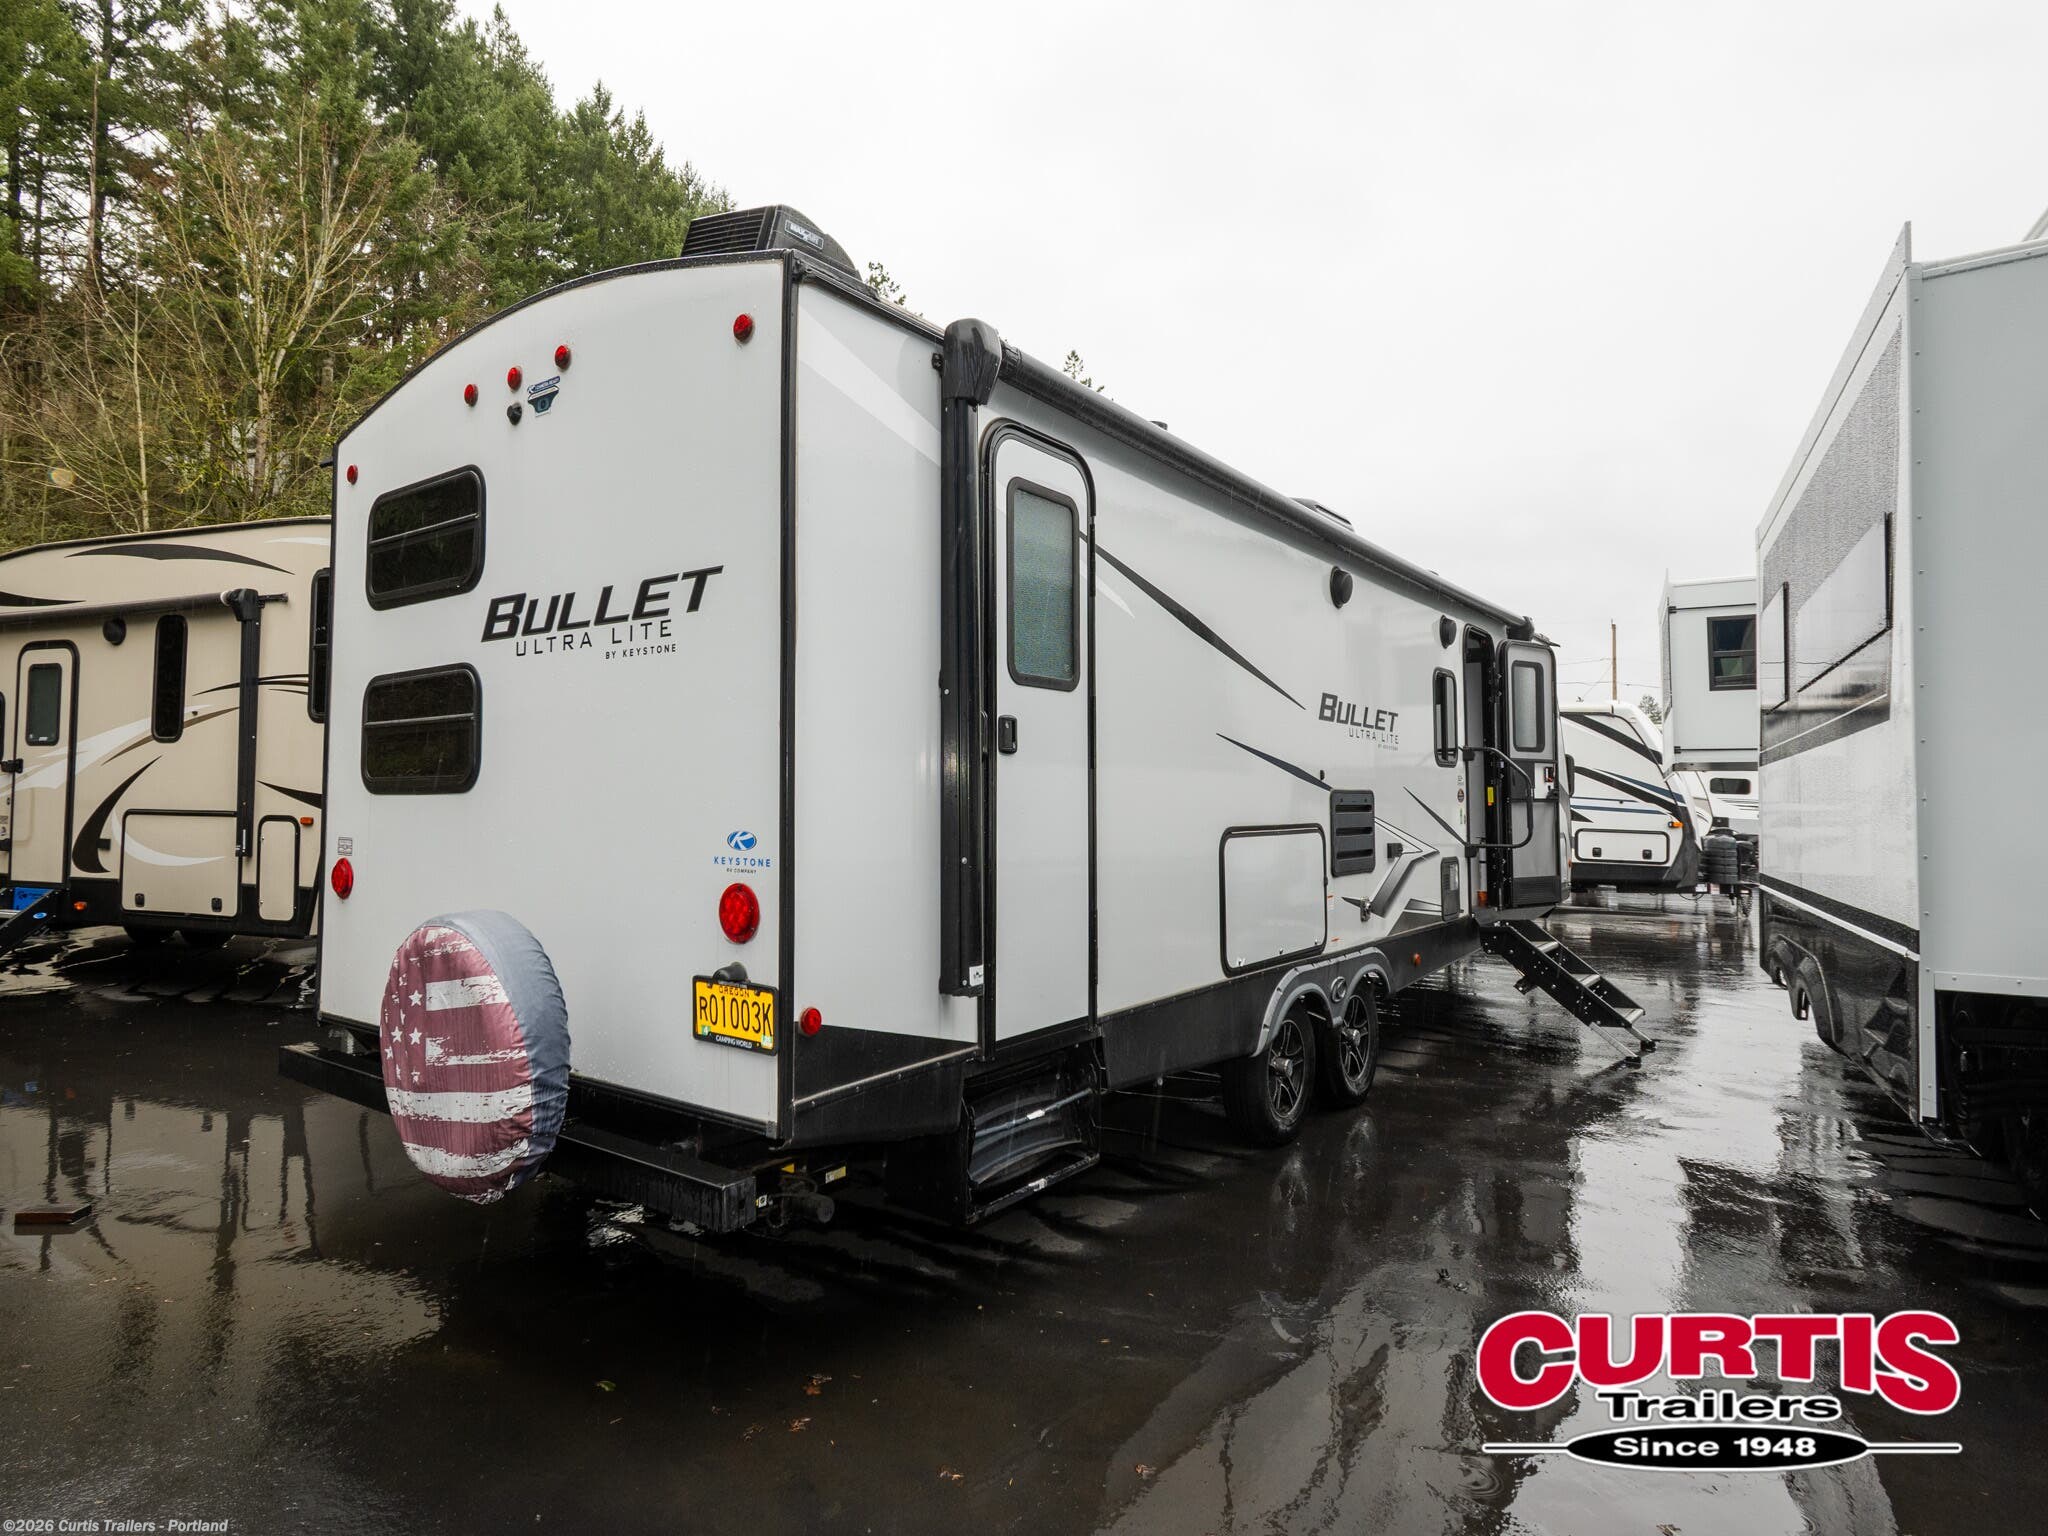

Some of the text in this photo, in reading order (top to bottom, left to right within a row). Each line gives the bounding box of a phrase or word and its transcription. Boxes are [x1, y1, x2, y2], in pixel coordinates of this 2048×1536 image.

[481, 565, 724, 643] BULLET
[516, 619, 672, 657] ULTRA LITE
[605, 643, 677, 660] BY KEYSTONE
[1318, 692, 1399, 732] BULLET
[1348, 727, 1399, 745] ULTRA LITE
[713, 856, 771, 868] KEYSTONE
[718, 985, 750, 998] OREGON
[699, 994, 772, 1037] R01003K
